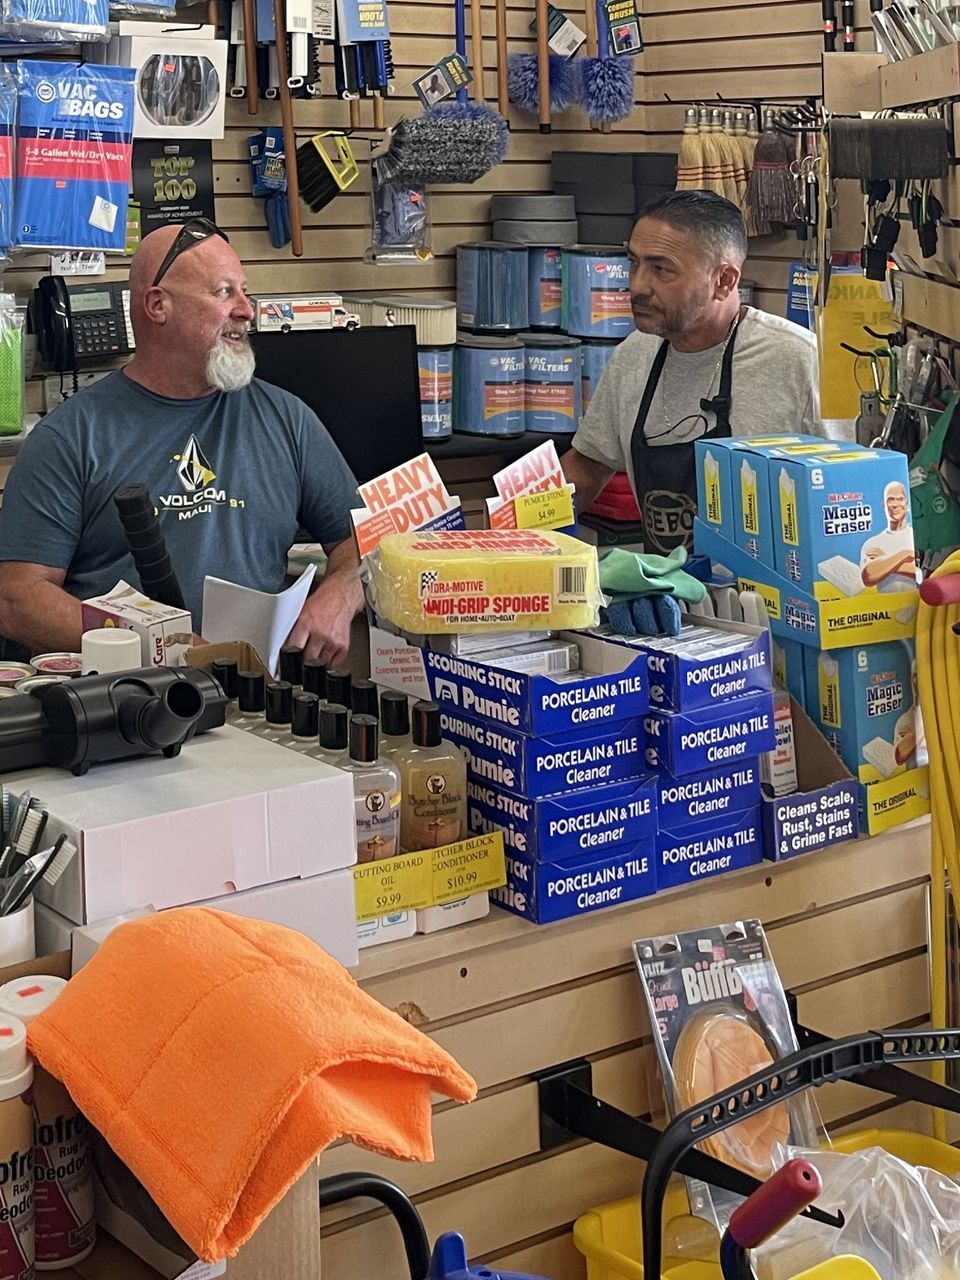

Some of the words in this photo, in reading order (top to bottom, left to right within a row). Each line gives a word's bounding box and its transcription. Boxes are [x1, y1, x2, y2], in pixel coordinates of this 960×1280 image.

[609, 9, 635, 21] BRUSH
[58, 82, 96, 100] VAC
[70, 99, 124, 120] BAGS
[41, 147, 69, 157] Gallon
[106, 151, 124, 161] Vacs
[151, 156, 195, 178] TOP
[153, 178, 197, 202] 100
[606, 264, 623, 272] VAC
[500, 356, 516, 365] VAC
[528, 356, 547, 365] VAC
[531, 363, 570, 372] FILTERS
[361, 455, 436, 515] HEAVY
[496, 446, 558, 502] HEAVY
[810, 468, 825, 485] 6
[159, 486, 227, 507] VOLCOM
[229, 498, 246, 509] 91
[178, 504, 213, 521] MAUI
[389, 483, 449, 534] DUTY
[823, 504, 872, 522] Magic
[824, 518, 873, 536] Eraser
[492, 595, 551, 613] SPONGE
[828, 618, 846, 628] THE
[847, 610, 892, 625] ORIGINAL
[428, 650, 487, 685] SCOURING
[487, 671, 521, 696] STICK
[686, 660, 742, 686] PORCELAIN
[749, 651, 766, 670] TILE
[542, 686, 609, 711] PORCELAIN
[618, 676, 642, 694] TILE
[710, 676, 747, 699] Cleaner
[866, 682, 903, 702] Magic
[463, 689, 521, 726] Pumie
[571, 702, 616, 724] Cleaner
[867, 697, 903, 717] Eraser
[681, 722, 741, 751] PORCELAIN
[748, 714, 769, 734] TILE
[484, 731, 517, 758] STICK
[536, 748, 606, 772] PORCELAIN
[614, 737, 638, 756] TILE
[707, 740, 747, 762] Cleaner
[566, 763, 612, 785] Cleaner
[661, 776, 725, 805] PORCELAIN
[732, 769, 754, 787] TILE
[496, 793, 529, 821] STICK
[688, 794, 730, 817] Cleaner
[777, 801, 818, 821] Cleans
[819, 790, 855, 810] Scale,
[872, 799, 888, 812] THE
[549, 808, 620, 837] PORCELAIN
[628, 799, 651, 817] TILE
[782, 816, 813, 838] Rust,
[814, 807, 851, 829] Stains
[465, 836, 495, 851] BLOCK
[579, 826, 625, 849] Cleaner
[662, 835, 727, 865] PORCELAIN
[734, 827, 756, 846] TILE
[791, 830, 826, 851] Grime
[827, 821, 854, 839] Fast
[353, 865, 391, 880] CUTTING
[392, 857, 424, 872] BOARD
[432, 850, 490, 872] CONDITIONER
[689, 854, 732, 877] Cleaner
[381, 876, 396, 886] OIL
[446, 871, 478, 890] $10.99
[547, 866, 617, 897] PORCELAIN
[625, 857, 649, 877] TILE
[375, 893, 402, 909] $9.99
[576, 885, 623, 909] Cleaner
[643, 961, 666, 978] FLITZ
[651, 994, 679, 1013] Large
